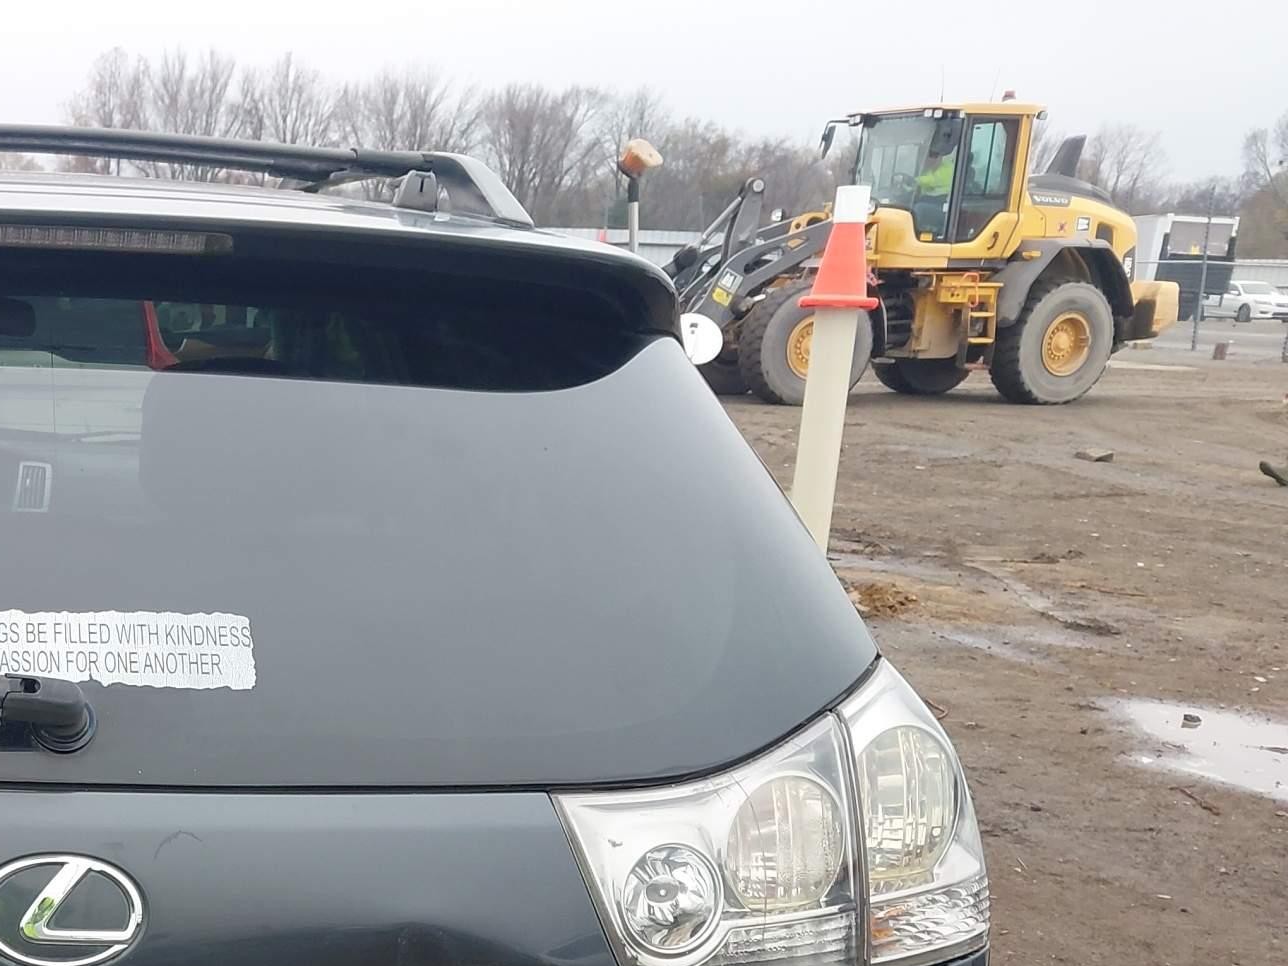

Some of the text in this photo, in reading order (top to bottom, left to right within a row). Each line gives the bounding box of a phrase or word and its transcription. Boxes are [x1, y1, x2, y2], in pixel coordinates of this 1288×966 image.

[25, 622, 49, 644] BE
[54, 622, 111, 645] FILLED
[115, 623, 159, 646] WITH
[165, 624, 253, 648] KINDNESS
[65, 650, 100, 673] FOR
[104, 651, 140, 674] ONE
[143, 652, 223, 675] ANOTHER
